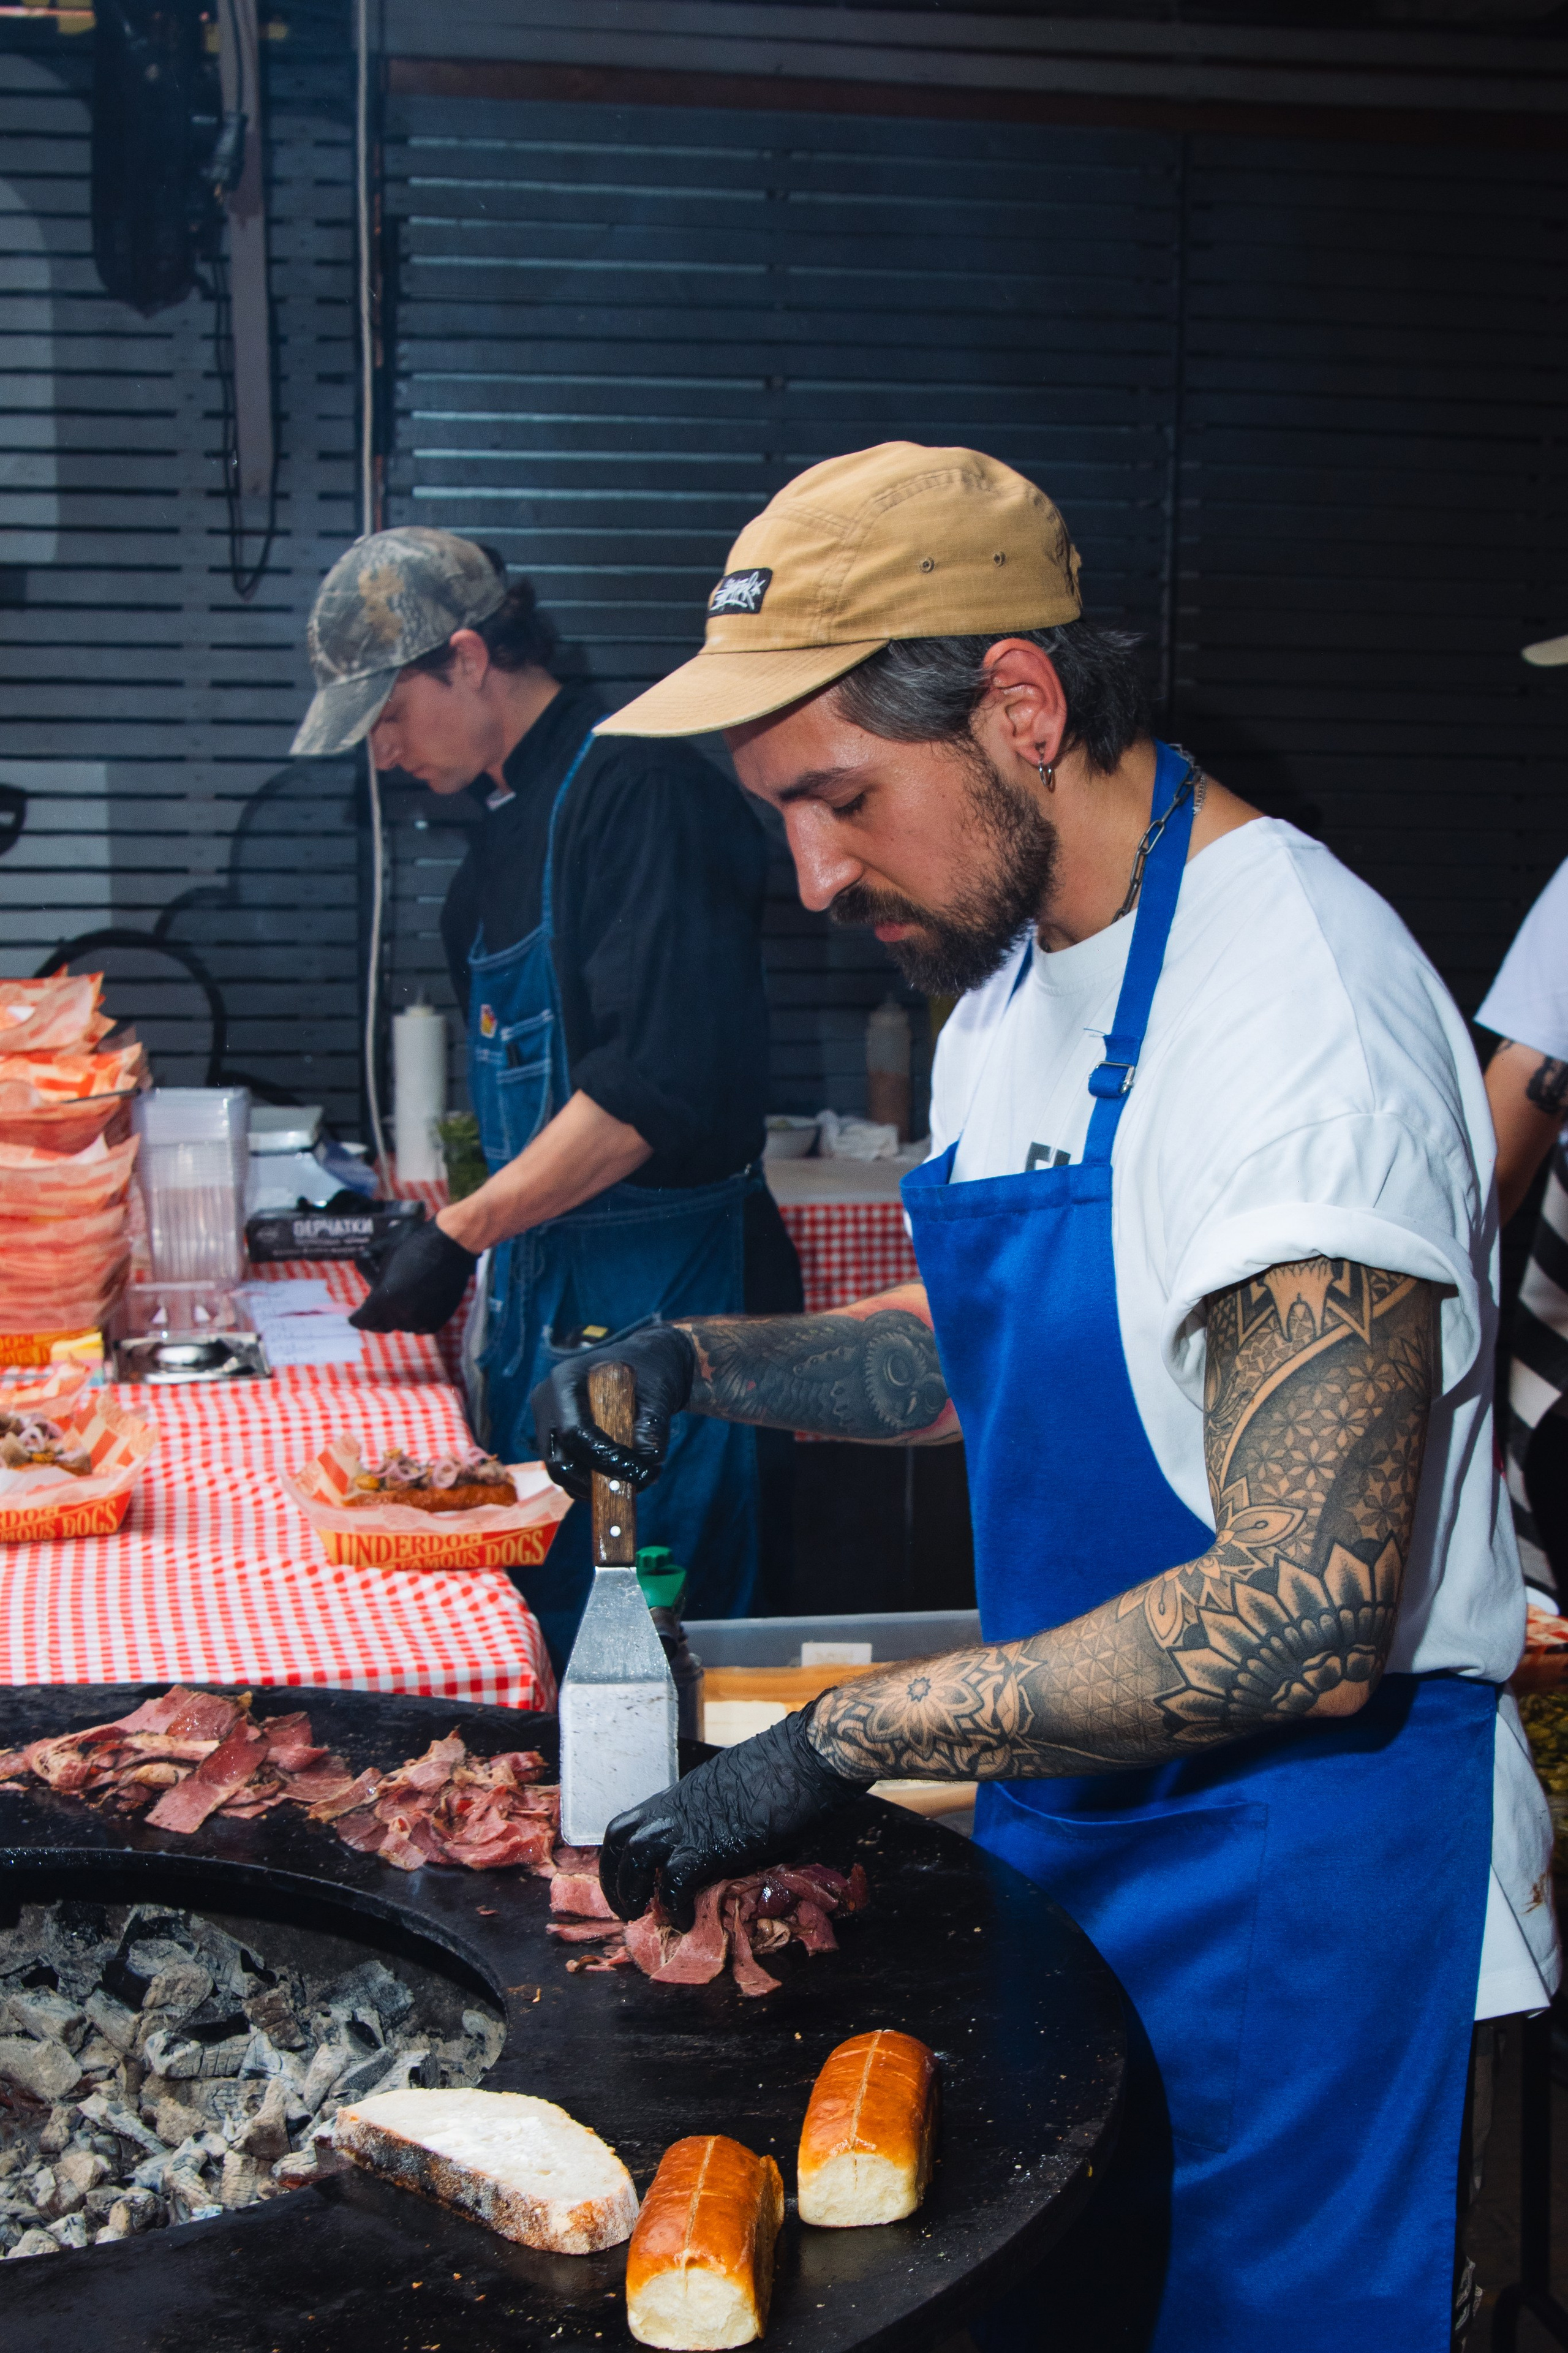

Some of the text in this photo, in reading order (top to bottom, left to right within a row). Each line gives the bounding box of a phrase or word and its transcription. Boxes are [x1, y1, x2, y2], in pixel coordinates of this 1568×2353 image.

[62, 1500, 118, 1538] DOGS
[334, 1532, 482, 1566] UNDERDOG
[484, 1530, 545, 1566] DOGS
